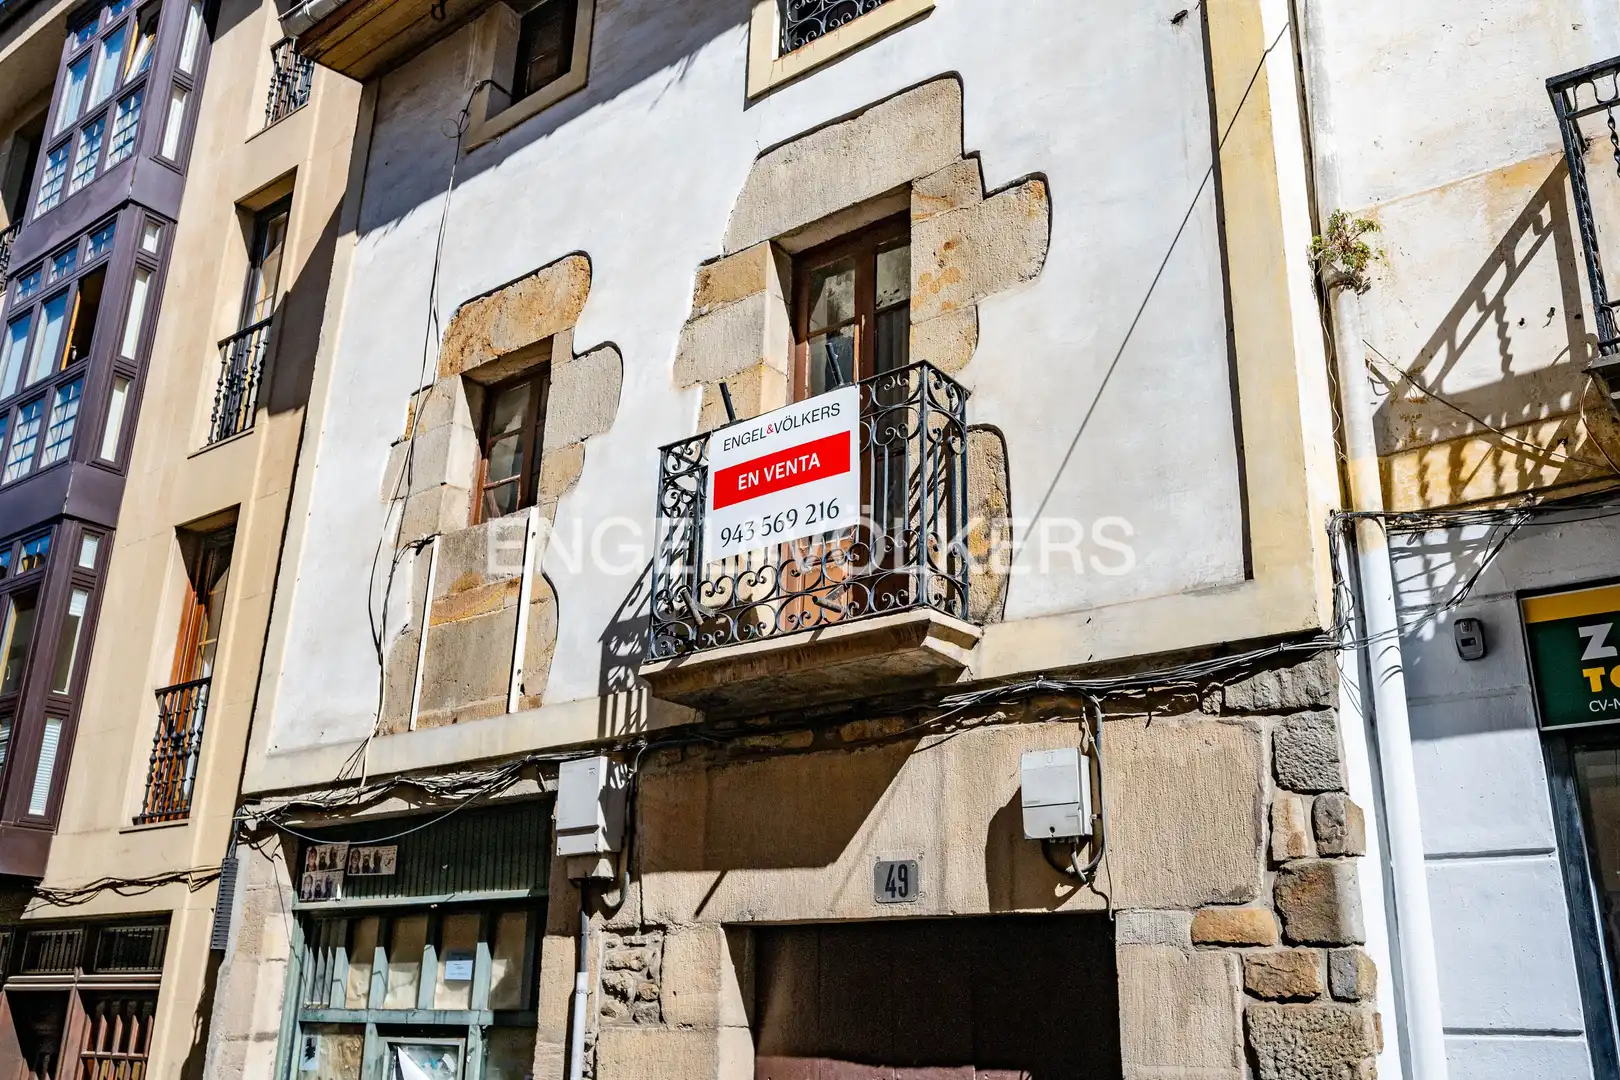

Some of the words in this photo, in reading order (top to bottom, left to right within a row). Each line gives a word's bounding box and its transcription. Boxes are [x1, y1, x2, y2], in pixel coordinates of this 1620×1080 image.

[723, 402, 841, 452] ENGEL&VÖLKERS
[737, 470, 760, 491] EN
[763, 452, 821, 483] VENTA
[720, 520, 756, 548] 943
[761, 508, 799, 537] 569
[805, 497, 840, 526] 216
[1578, 622, 1618, 661] Z
[885, 864, 908, 898] 49
